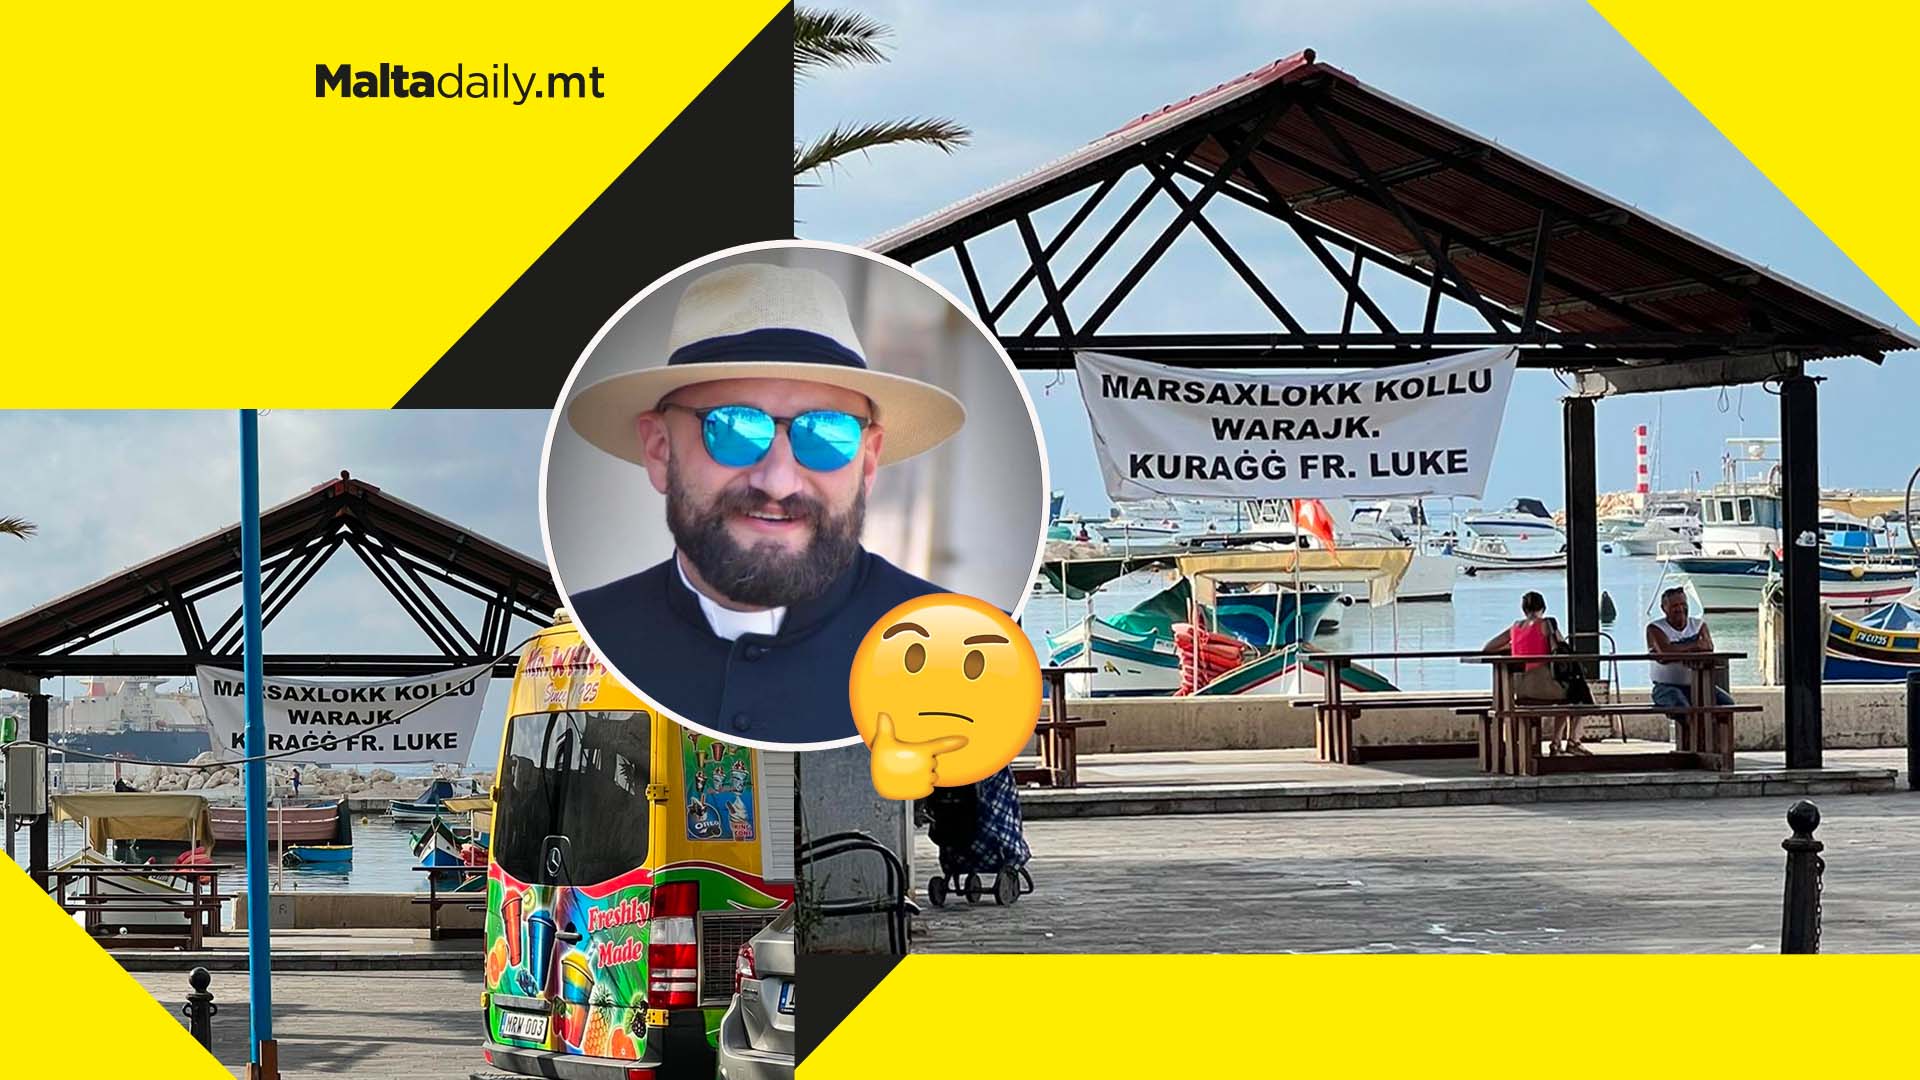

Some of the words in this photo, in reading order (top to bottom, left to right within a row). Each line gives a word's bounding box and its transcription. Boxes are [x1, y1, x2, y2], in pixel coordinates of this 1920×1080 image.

[1102, 373, 1361, 406] MARSAXLOKK
[1374, 368, 1493, 403] KOLLU
[1210, 415, 1380, 441] WARAJK.
[1129, 447, 1288, 481] KURAĠĠ
[1300, 453, 1357, 480] FR.
[1369, 448, 1469, 478] LUKE
[213, 679, 387, 703] MASAXLOKK
[395, 680, 476, 700] KOLLU
[287, 708, 401, 726] WARAJK.
[231, 730, 337, 751] KRAĠĠ
[347, 733, 384, 751] FR.
[393, 732, 458, 750] LUKE
[588, 897, 650, 932] Freshly
[597, 937, 643, 968] Made
[505, 1014, 525, 1033] MRW
[525, 1018, 544, 1036] 003
